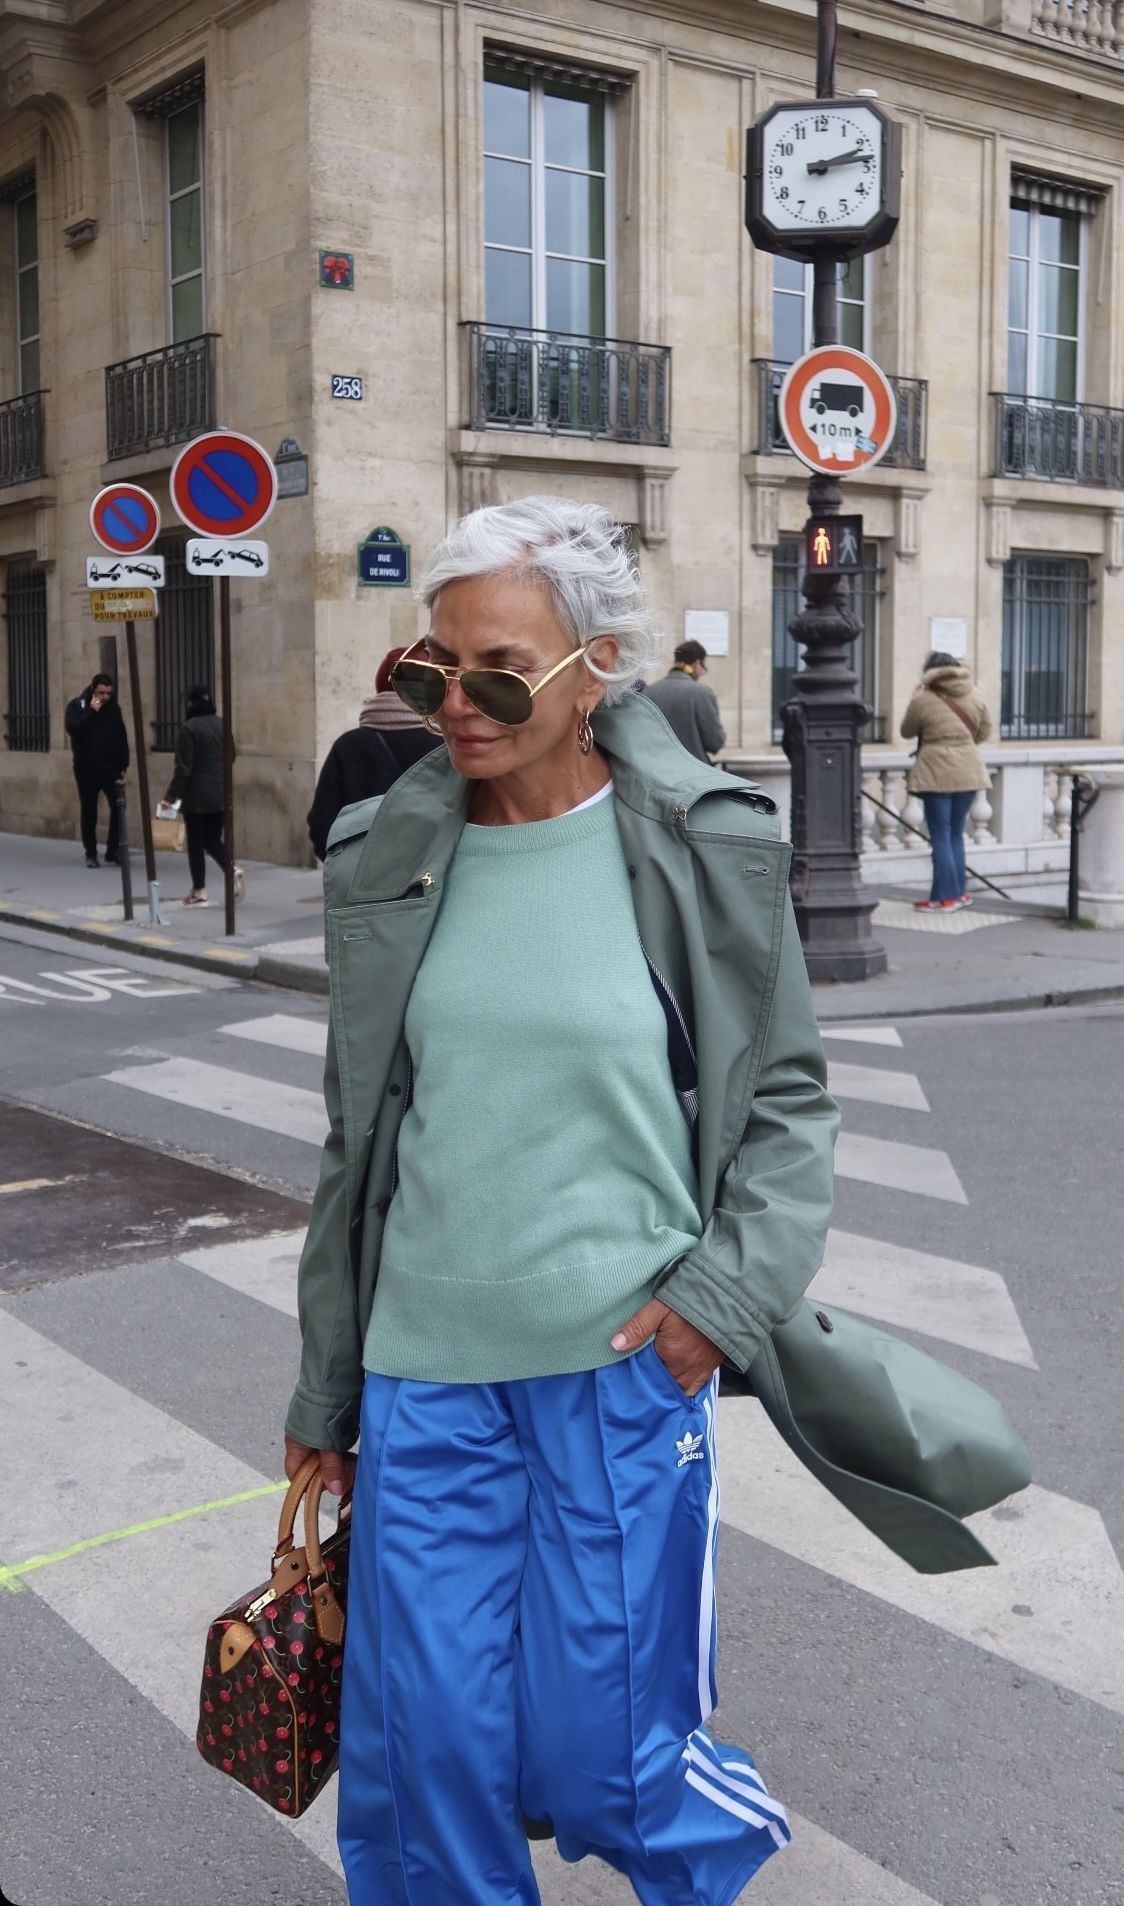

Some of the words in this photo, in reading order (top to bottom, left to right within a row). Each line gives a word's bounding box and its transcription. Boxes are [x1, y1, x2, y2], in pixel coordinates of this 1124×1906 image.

[814, 118, 829, 132] 12
[841, 124, 847, 137] 1
[795, 127, 806, 140] 11
[780, 143, 794, 156] 10
[856, 138, 865, 151] 2
[774, 165, 783, 178] 9
[780, 186, 789, 200] 8
[855, 182, 865, 196] 4
[798, 200, 806, 214] 7
[838, 199, 848, 212] 5
[818, 206, 827, 220] 6
[333, 376, 361, 399] 258
[377, 553, 392, 563] RUE
[369, 567, 378, 576] DE
[379, 567, 401, 577] RIVOLI
[107, 591, 144, 600] COMPTER
[94, 612, 116, 621] POUR
